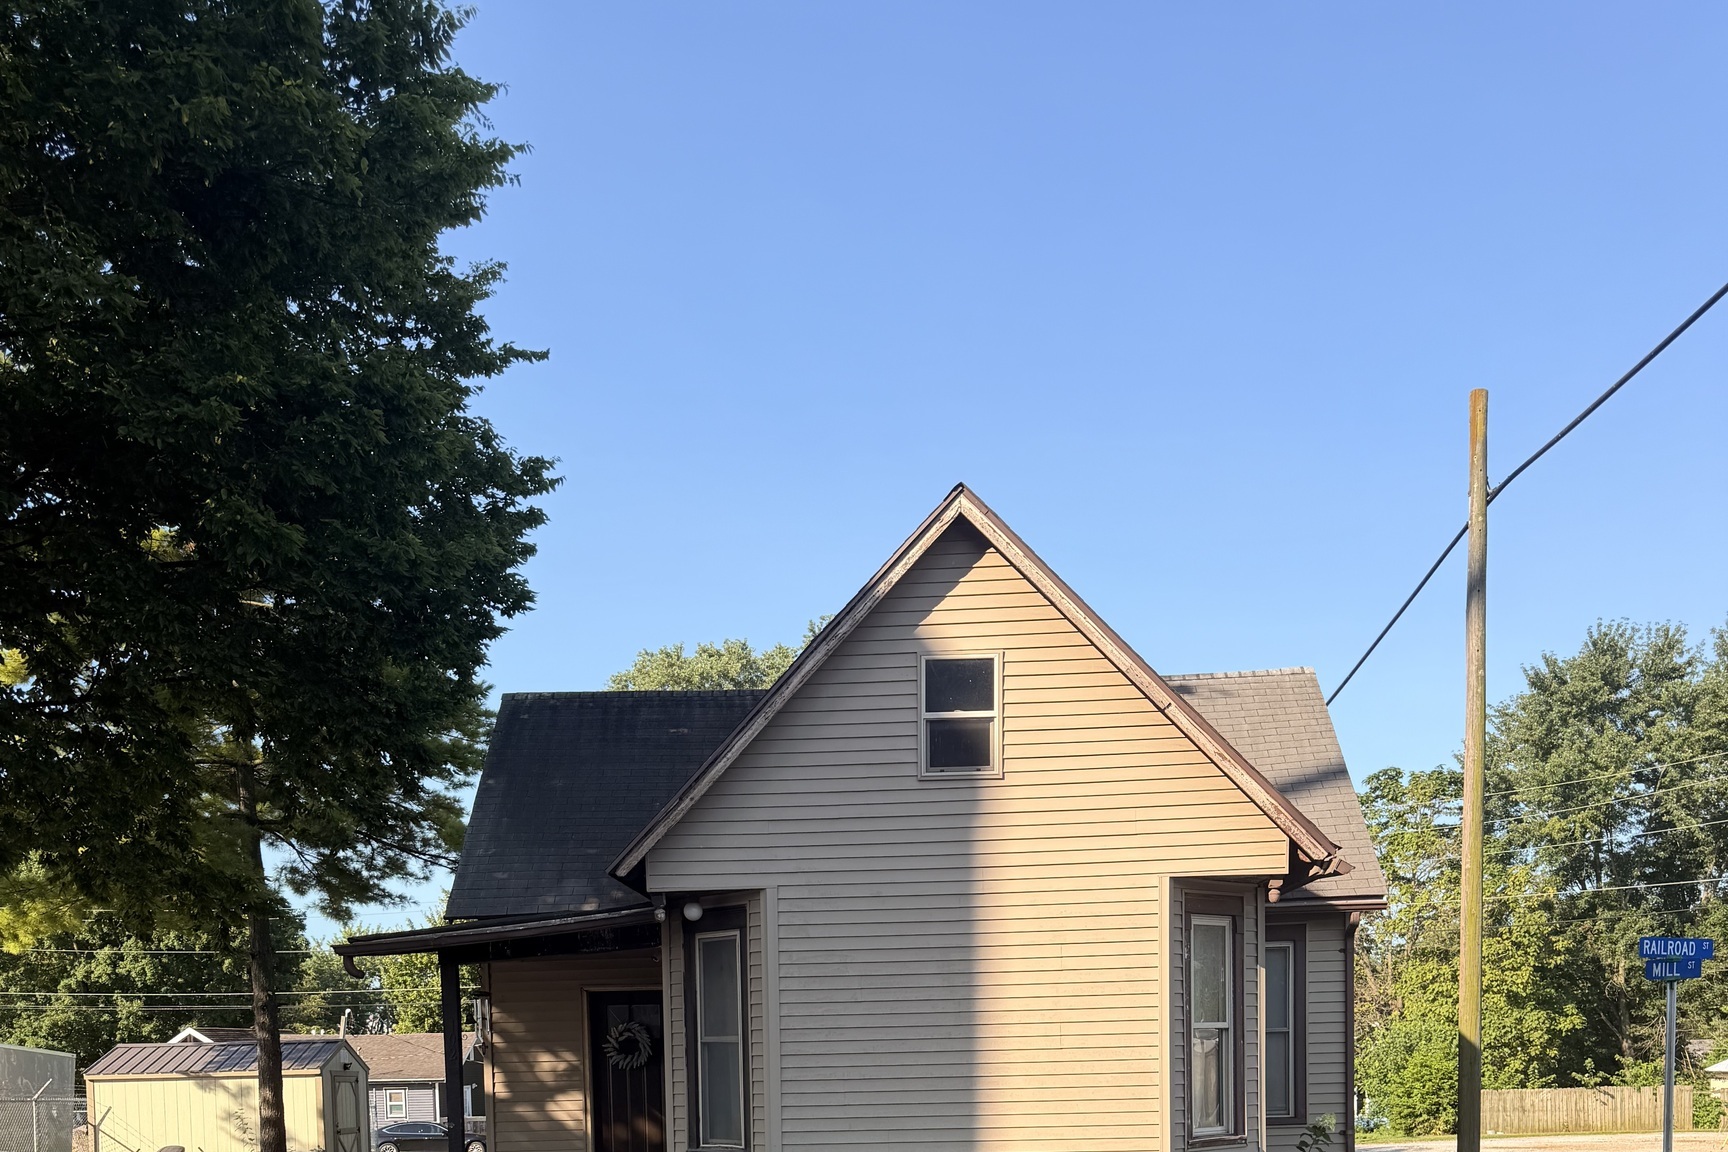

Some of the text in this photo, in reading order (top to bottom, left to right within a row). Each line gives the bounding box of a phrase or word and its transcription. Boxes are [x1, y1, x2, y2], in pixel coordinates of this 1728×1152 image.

[1643, 940, 1710, 956] RAILROAD ST
[1652, 961, 1695, 977] MILL ST
